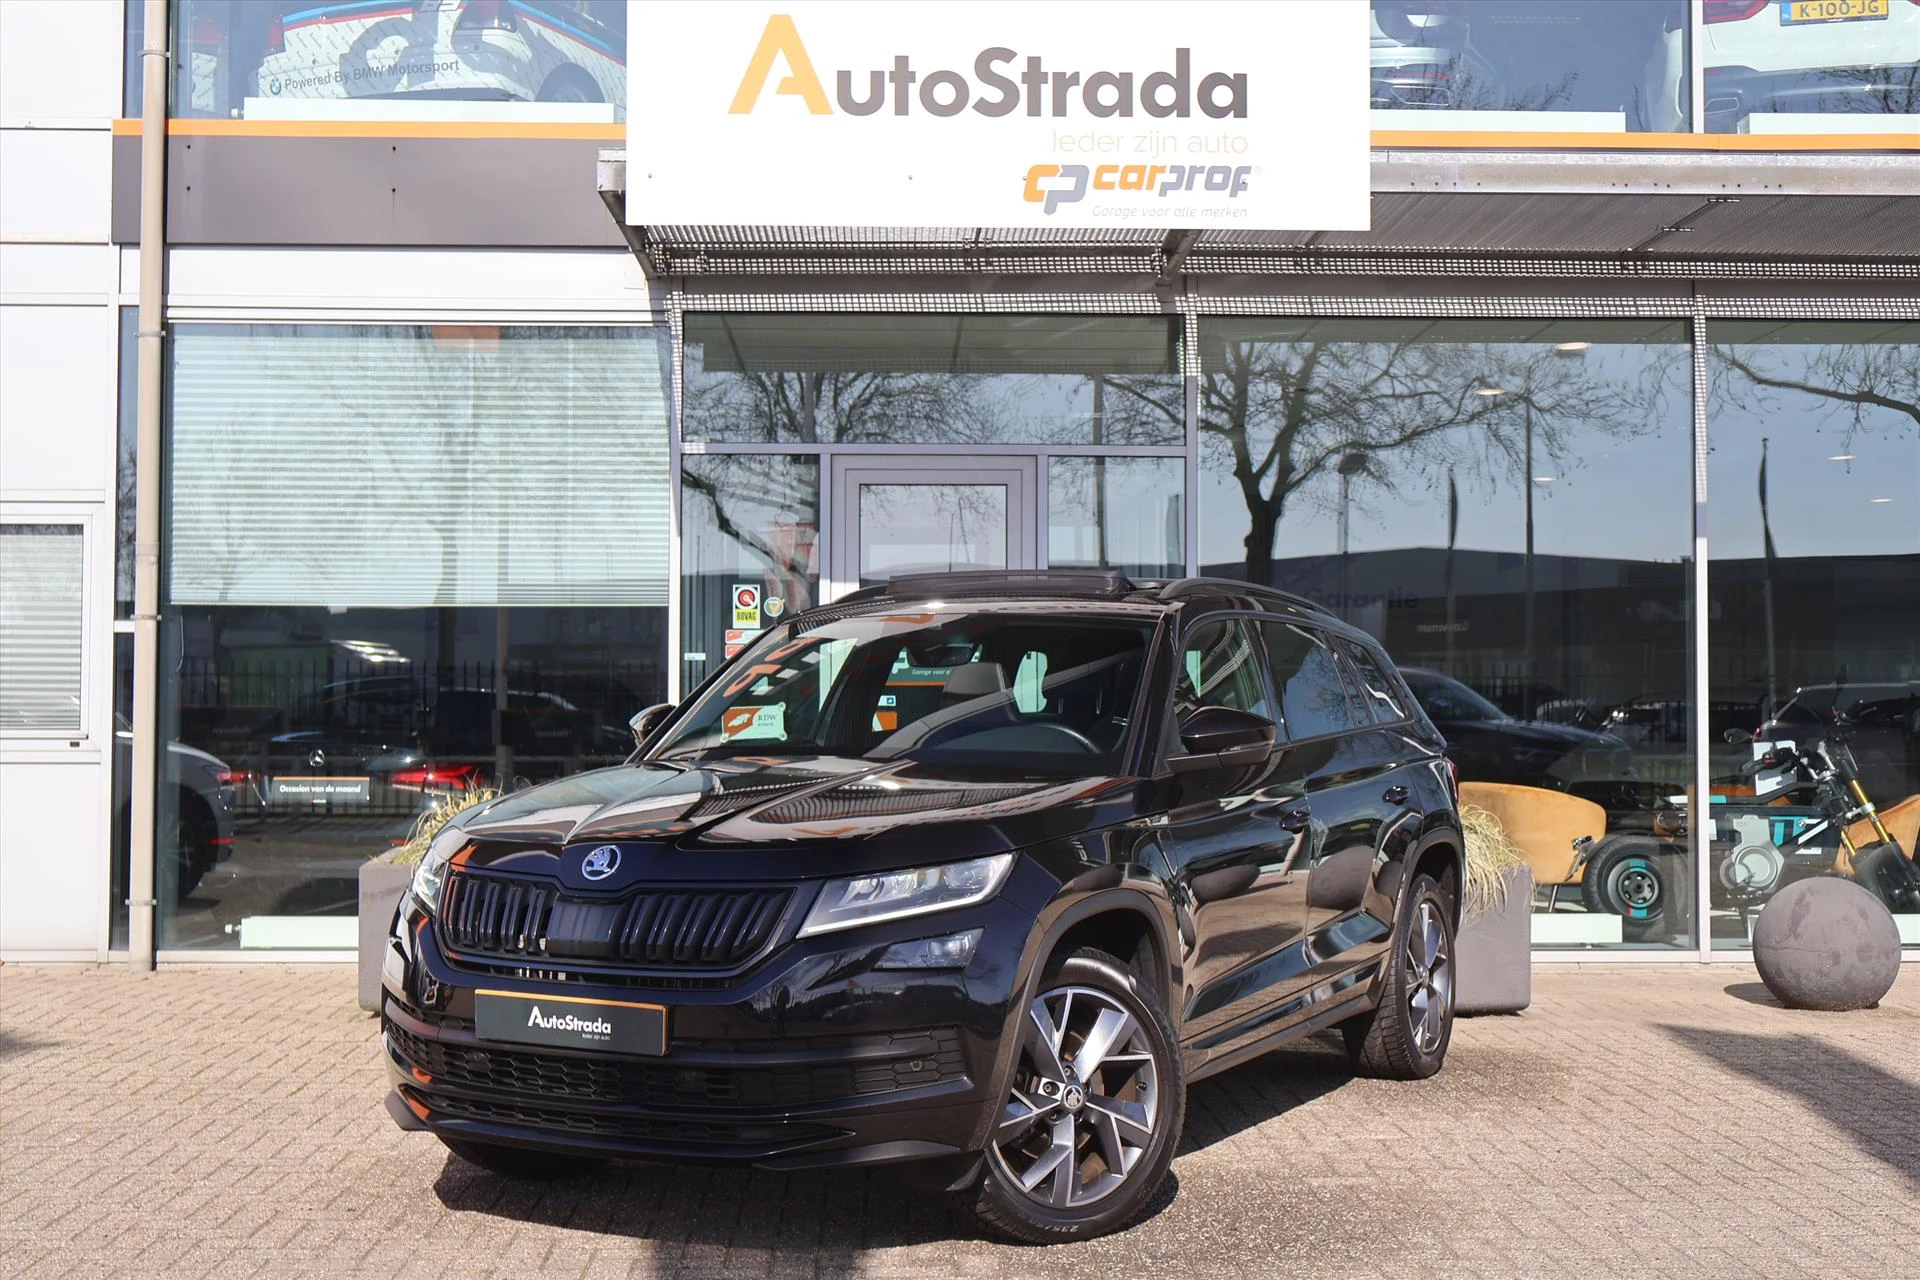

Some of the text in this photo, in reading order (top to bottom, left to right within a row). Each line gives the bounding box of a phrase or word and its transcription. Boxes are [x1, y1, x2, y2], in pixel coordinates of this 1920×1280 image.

[1799, 0, 1880, 18] K-100-JG
[284, 59, 460, 90] Powered By BMW Motorsport
[727, 14, 1248, 119] AutoStrada
[1053, 128, 1250, 159] Ieder zijn auto
[1092, 205, 1248, 219] Garage voor alle merken
[736, 611, 757, 621] BOVAG
[911, 668, 932, 677] Garage
[279, 784, 310, 793] Occasion
[325, 784, 335, 793] de
[335, 784, 361, 793] maand
[527, 1005, 612, 1035] AutoStrada
